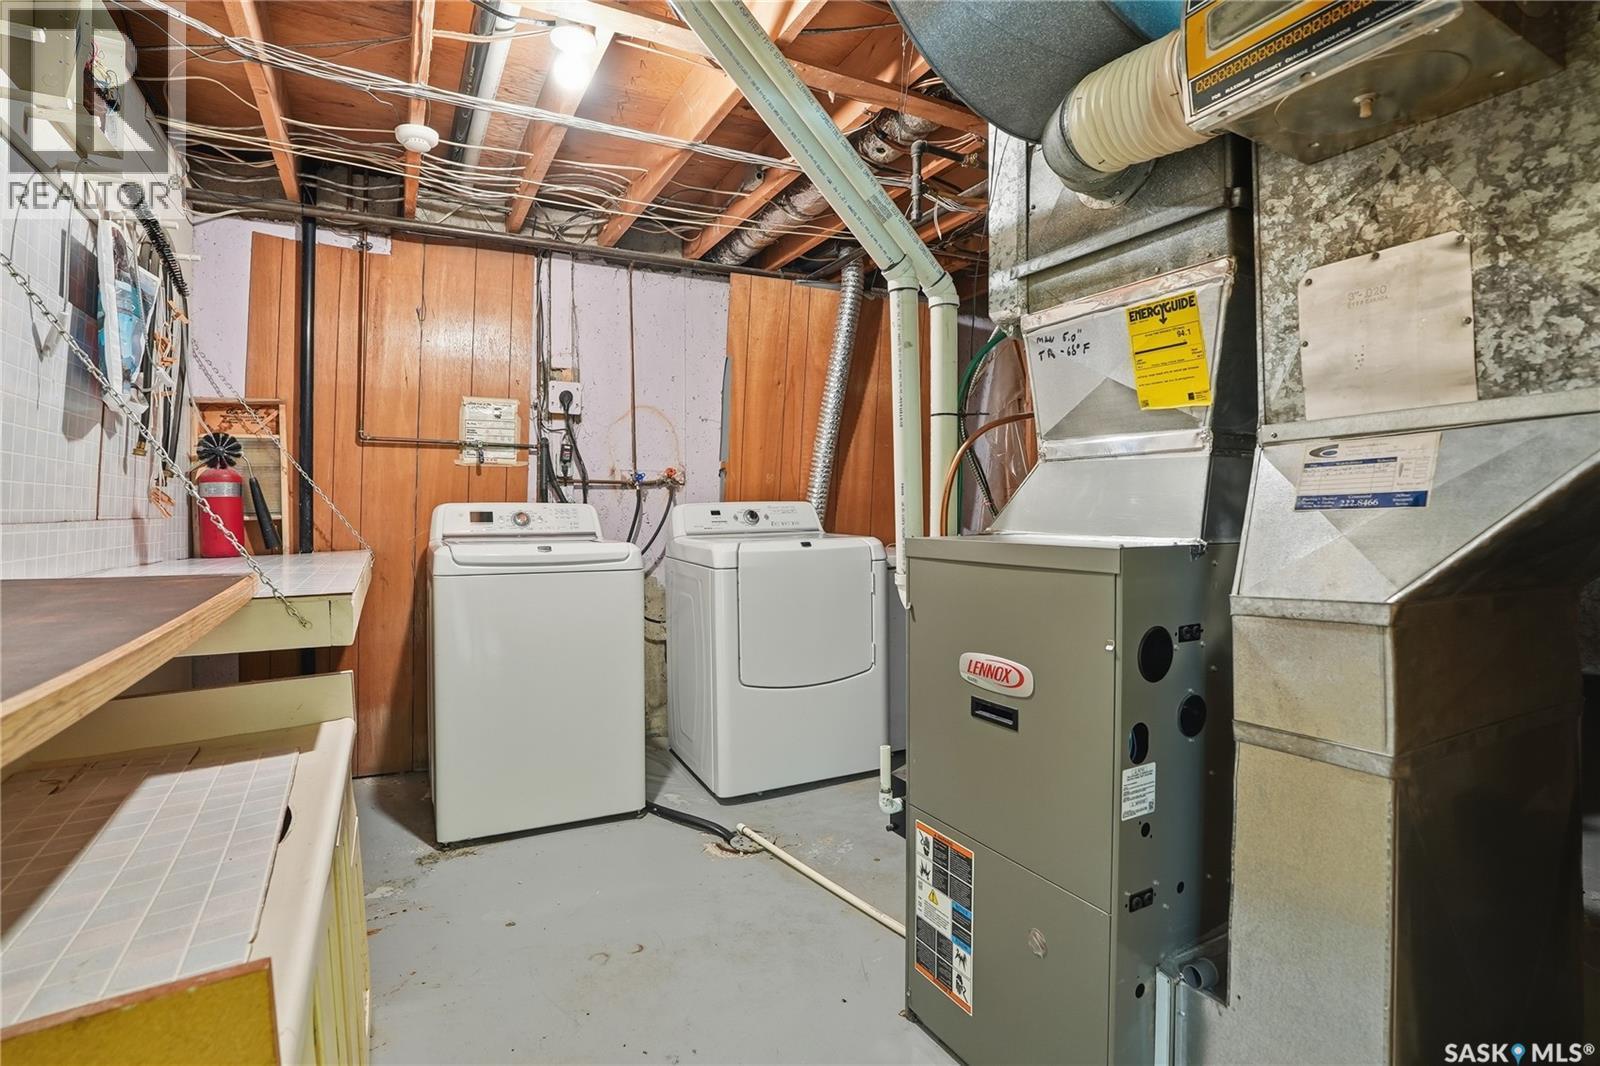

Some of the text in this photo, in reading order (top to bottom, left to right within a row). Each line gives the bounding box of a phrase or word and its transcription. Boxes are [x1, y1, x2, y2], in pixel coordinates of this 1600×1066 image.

[1211, 93, 1222, 101] FOR
[1225, 78, 1251, 95] MAXIMUM
[1254, 62, 1283, 80] EFFICIENCY
[1285, 48, 1309, 63] CHANGE
[1312, 27, 1352, 50] EVAPORATOR
[1129, 295, 1197, 324] ENERGYGUIDE
[1176, 329, 1192, 338] 94.1
[1340, 498, 1379, 507] 222.8466
[967, 659, 1013, 684] LENNOX
